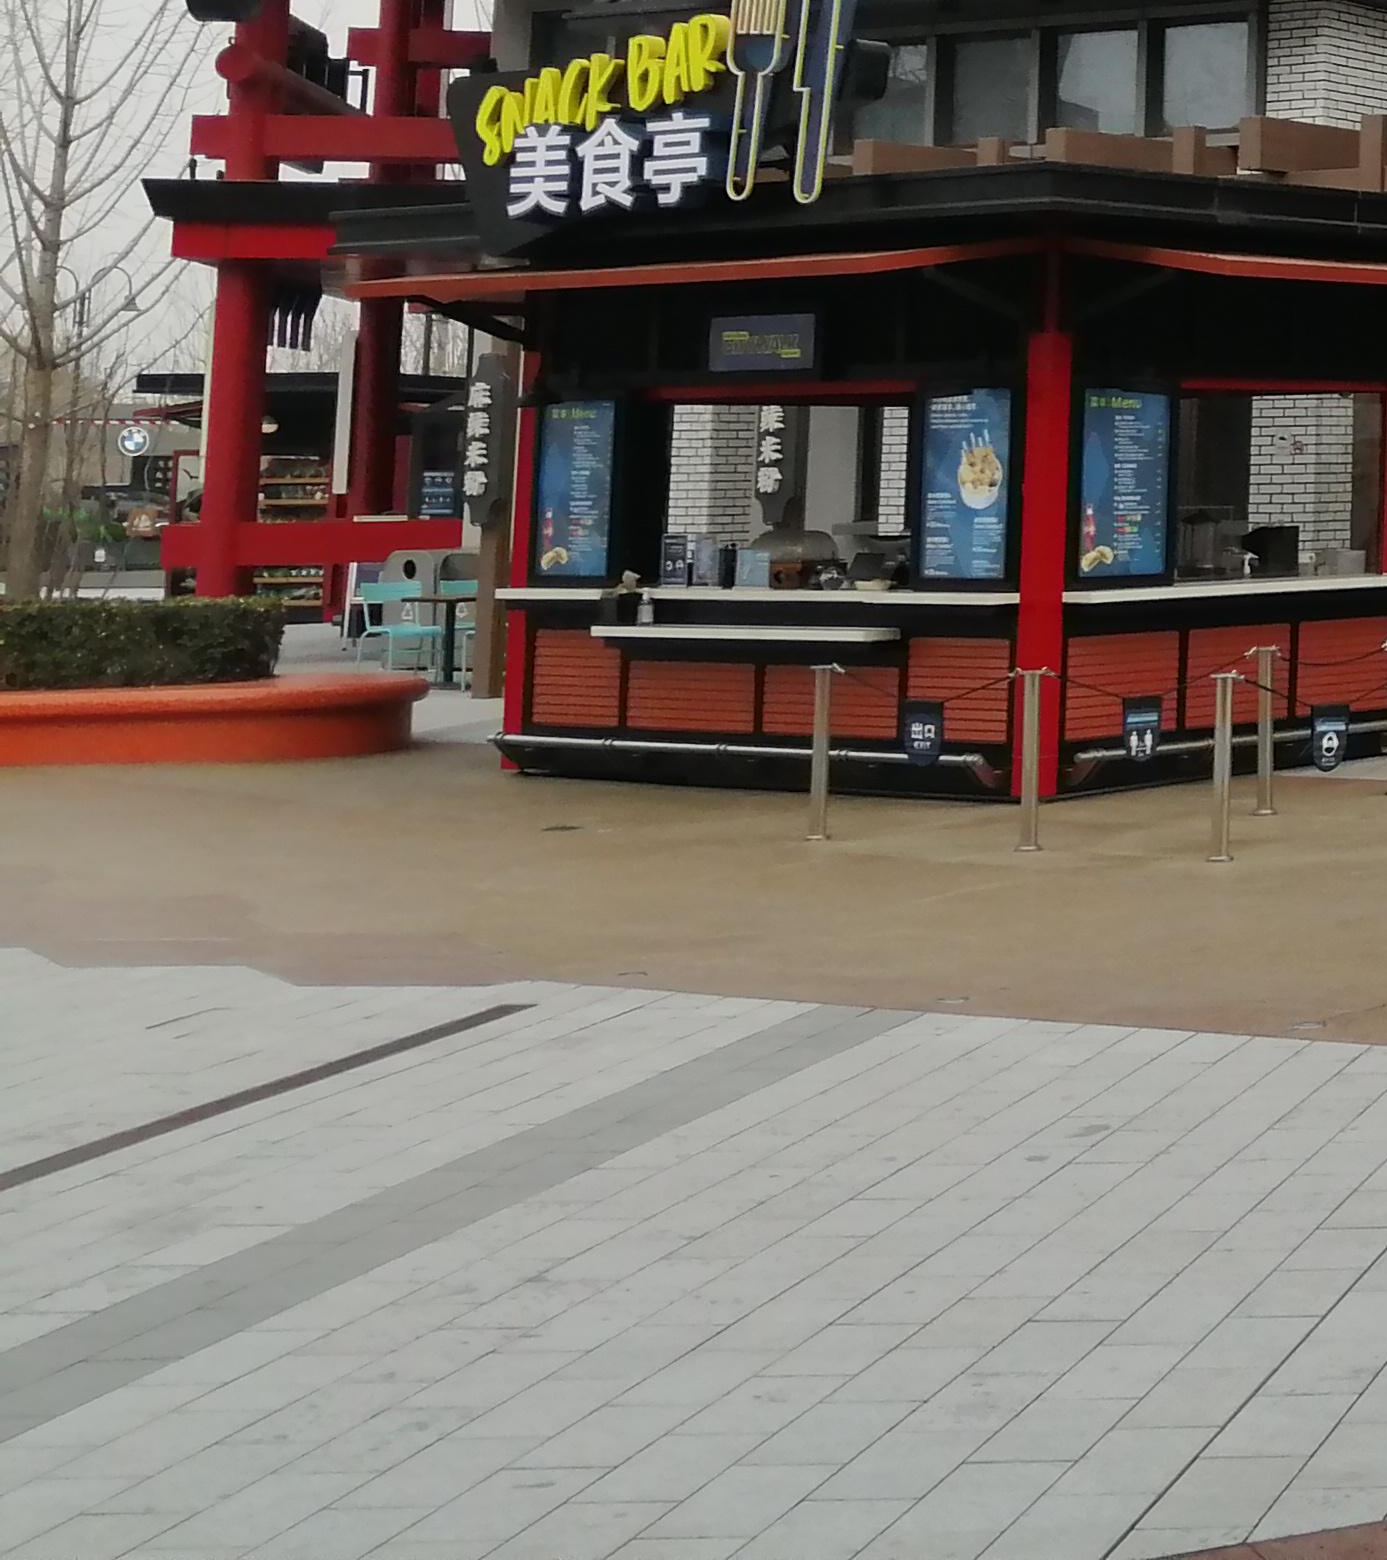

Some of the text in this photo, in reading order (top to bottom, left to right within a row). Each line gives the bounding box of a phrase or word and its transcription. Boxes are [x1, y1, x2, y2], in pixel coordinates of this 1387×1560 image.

[476, 14, 731, 166] SNACK BAR
[506, 112, 711, 217] 美食亭
